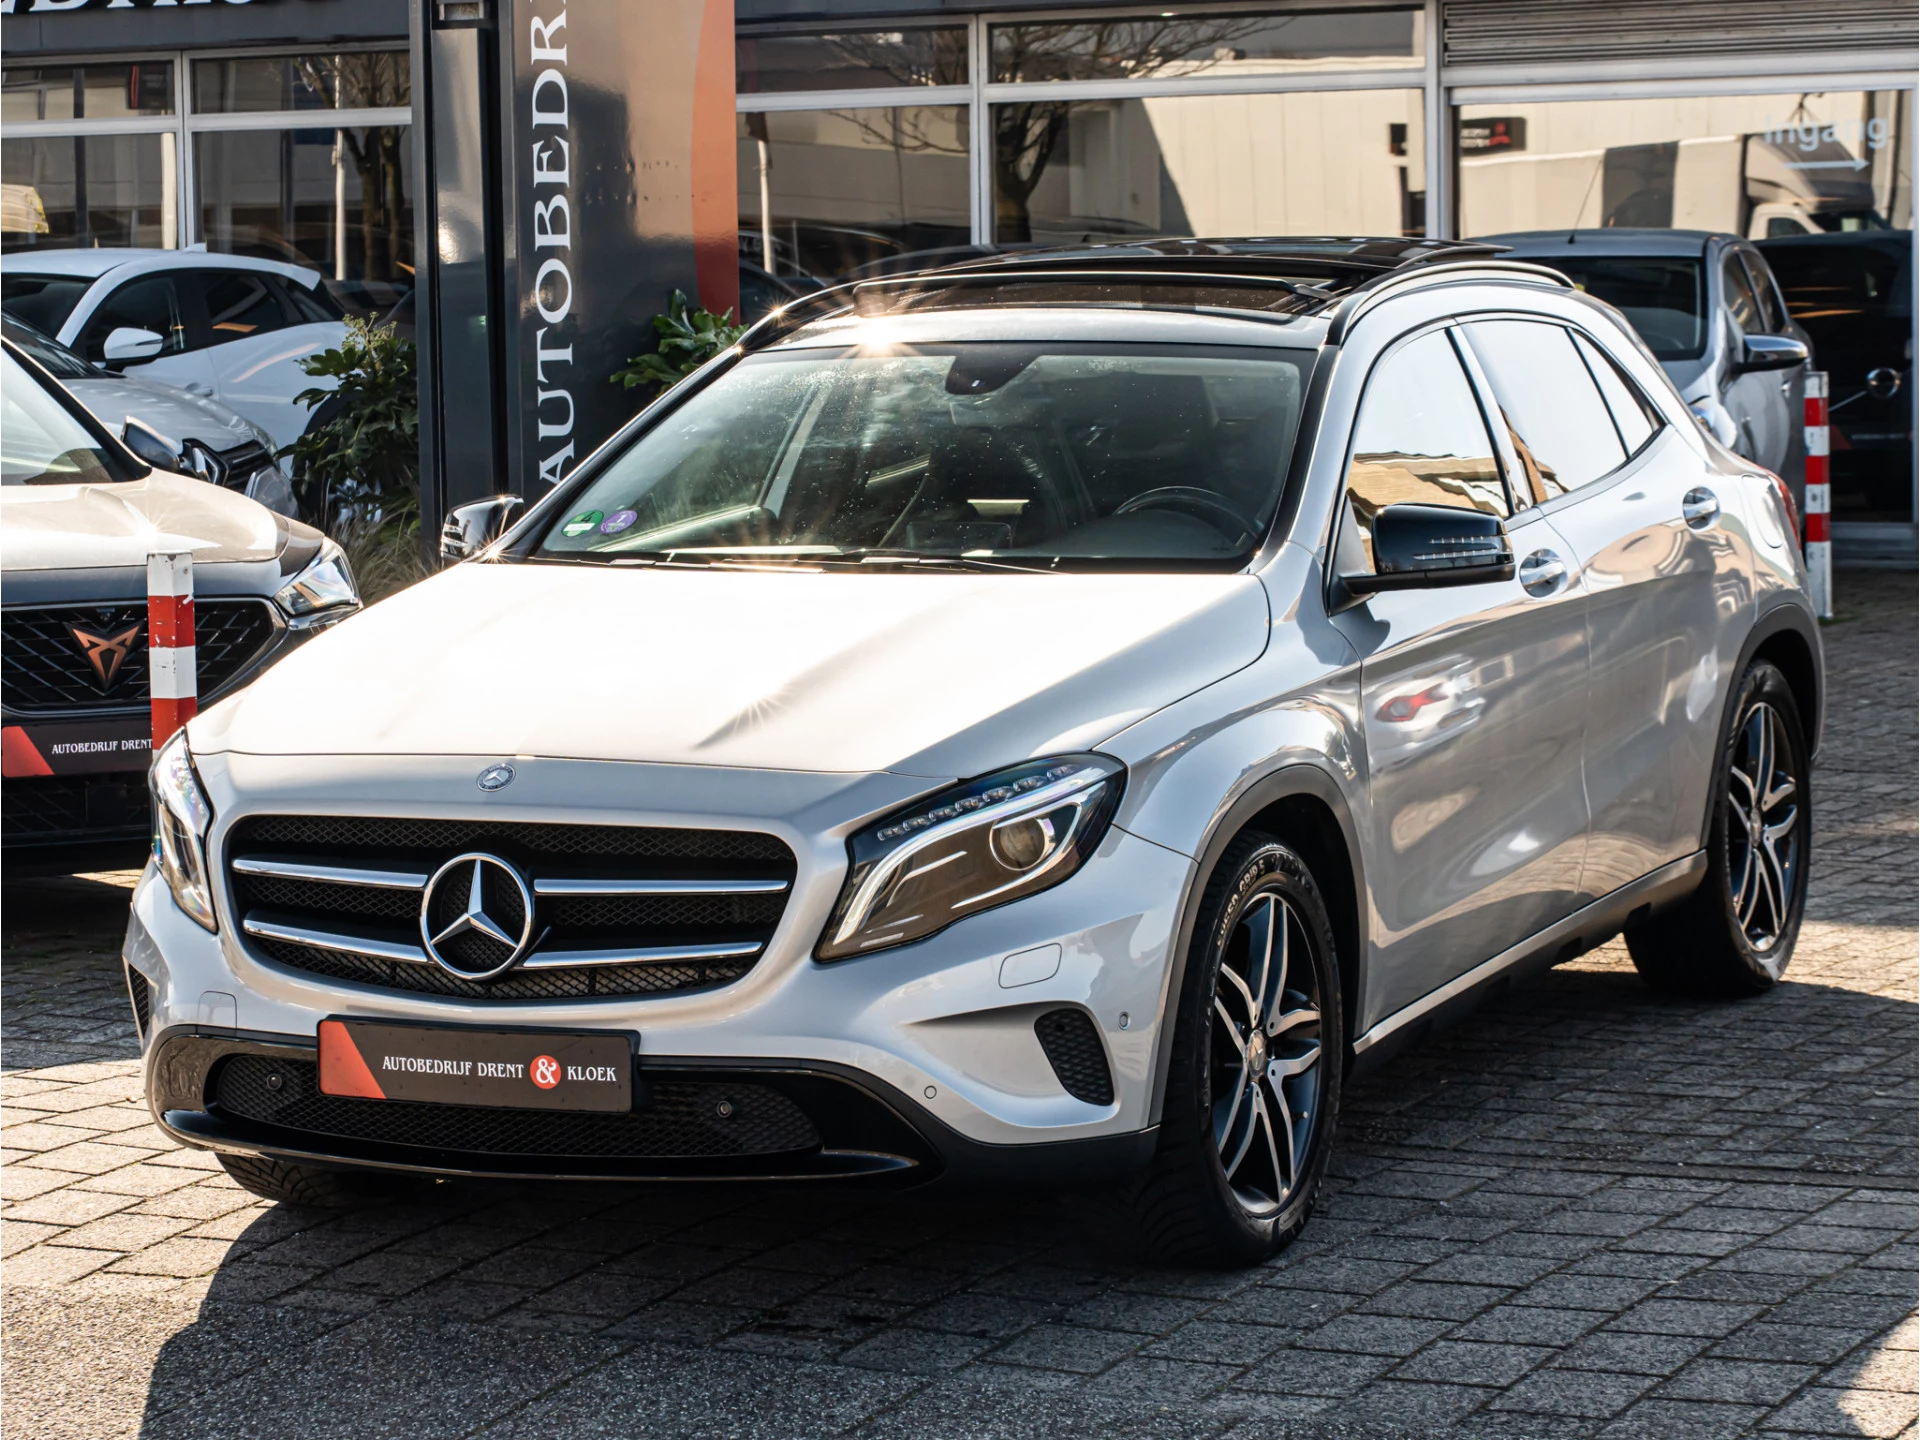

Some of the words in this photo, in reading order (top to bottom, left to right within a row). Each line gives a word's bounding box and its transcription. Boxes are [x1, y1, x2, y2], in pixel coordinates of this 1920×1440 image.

[529, 0, 575, 486] AUTOBEDR
[51, 740, 119, 755] AUTOBEDRIJF
[121, 738, 153, 751] DRENT
[382, 1056, 472, 1076] AUTOBEDRIJF
[477, 1062, 524, 1079] DRENT
[535, 1058, 557, 1084] &
[567, 1066, 617, 1082] KLOEK
